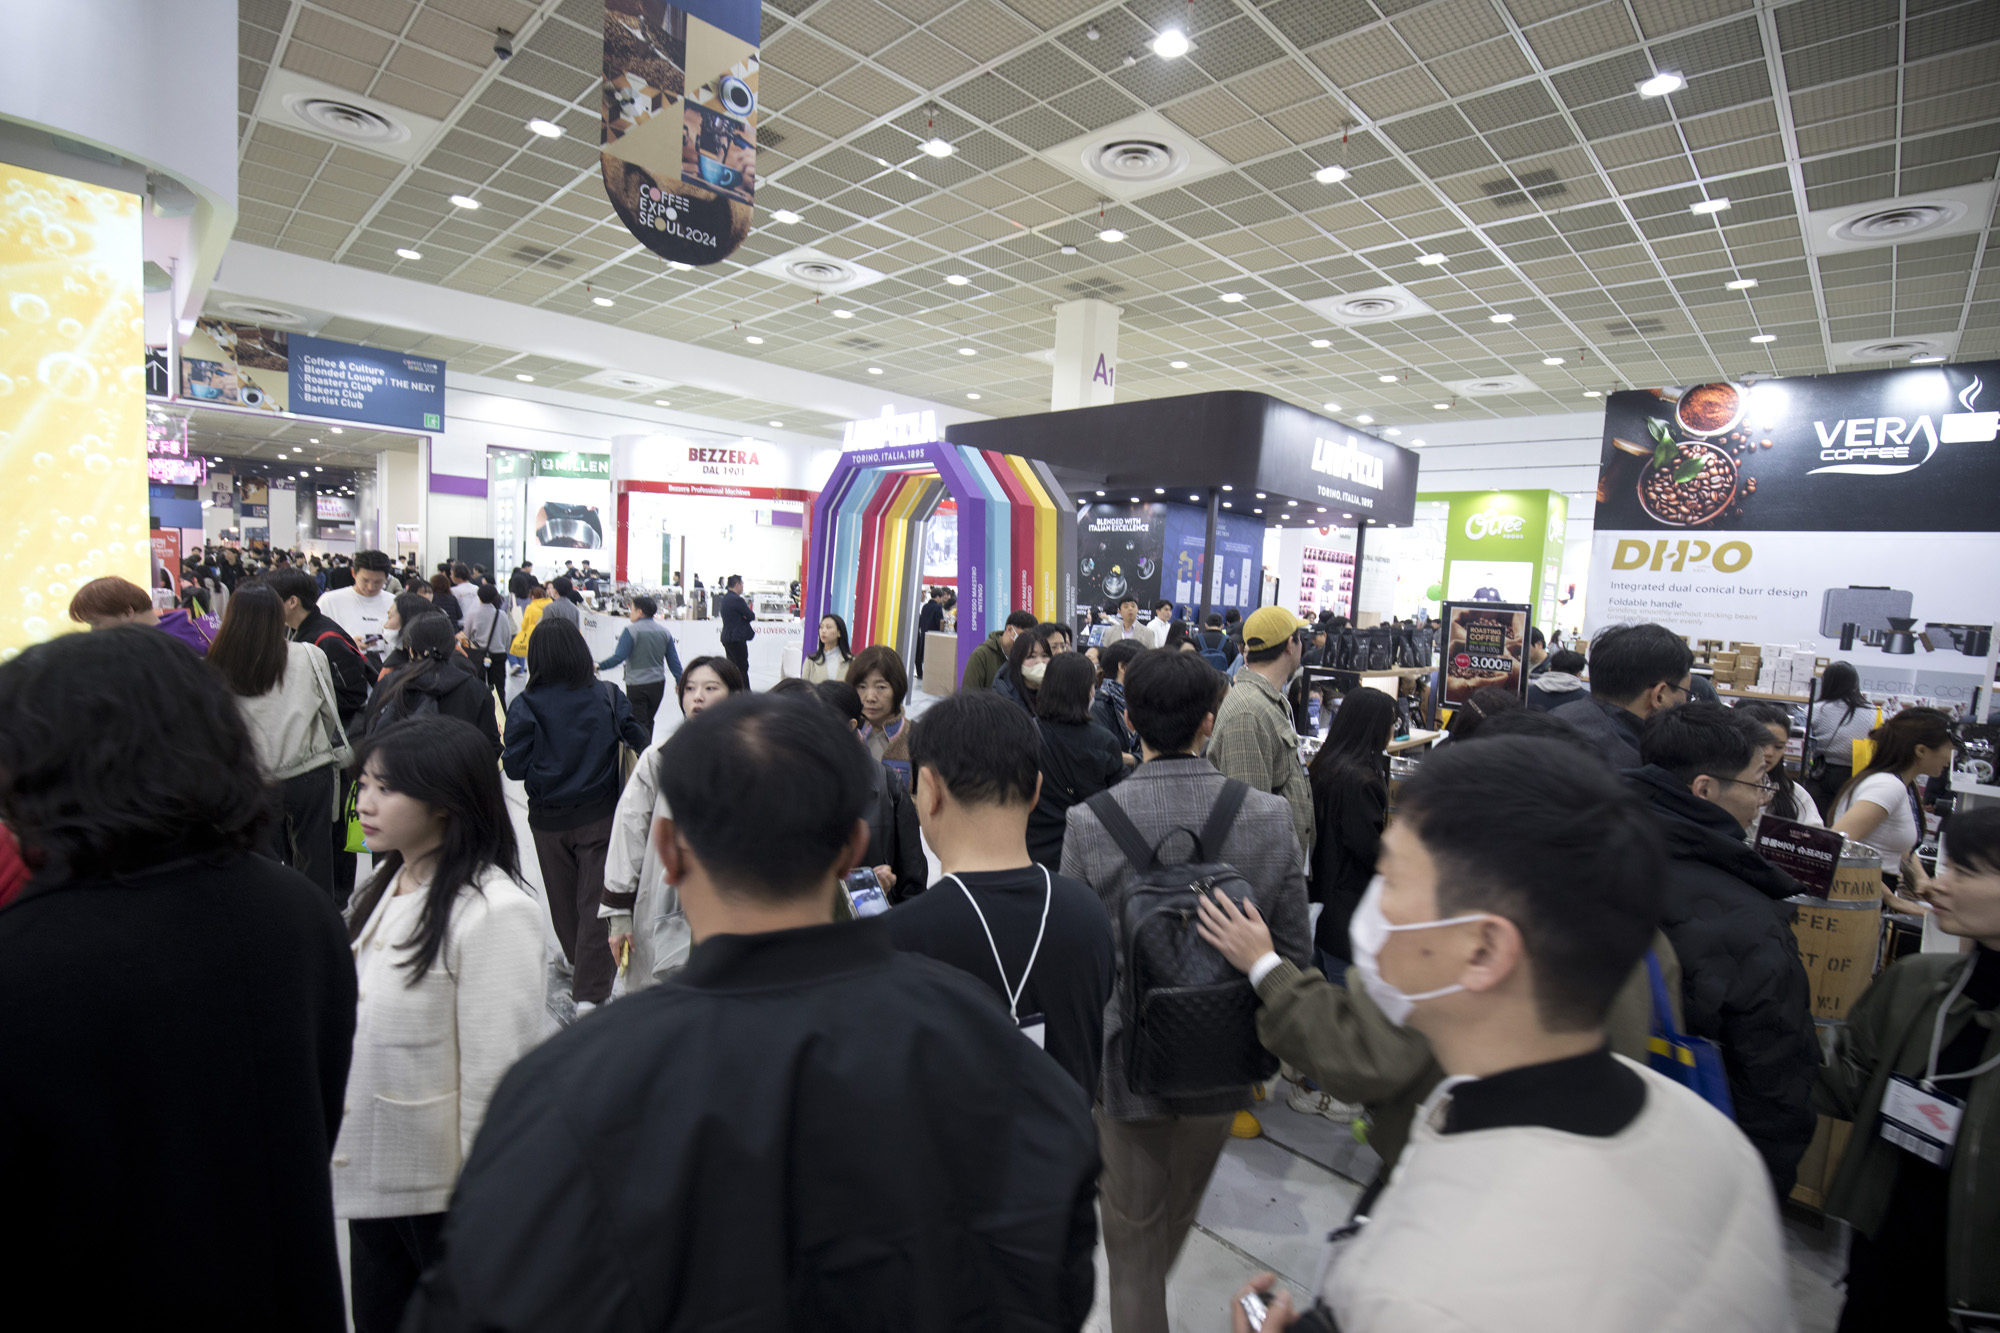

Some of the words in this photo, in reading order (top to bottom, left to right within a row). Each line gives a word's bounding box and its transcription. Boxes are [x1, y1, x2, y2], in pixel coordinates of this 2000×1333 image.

[640, 184, 690, 213] COFFEE
[639, 199, 678, 221] EXPO
[304, 355, 337, 369] Coffee
[339, 361, 346, 370] &
[349, 363, 385, 376] Culture
[304, 365, 346, 379] Blended
[348, 372, 383, 386] Lounge
[390, 378, 409, 389] THE
[411, 383, 436, 393] NEXT
[304, 374, 349, 389] Roasters
[352, 381, 373, 393] Club
[304, 384, 340, 397] Bakers
[342, 389, 365, 400] Club
[304, 393, 338, 406] Bartist
[340, 398, 363, 409] Club
[1814, 415, 1938, 449] VERA
[688, 447, 759, 465] BEZZERA
[907, 448, 925, 459] 1895
[1820, 446, 1910, 461] COFFEE
[555, 460, 609, 473] MILLEN
[702, 465, 719, 475] DAL
[723, 466, 745, 476] 1901
[691, 486, 724, 495] Professional
[725, 488, 751, 496] Machines
[1361, 497, 1374, 508] 1895
[1088, 524, 1111, 532] ITALIAN
[1111, 523, 1149, 532] EXCELLENCE
[1124, 517, 1141, 525] WITH
[1610, 581, 1665, 593] Integrated
[1668, 583, 1692, 593] dual
[1695, 584, 1735, 595] conical
[1739, 585, 1763, 596] burr
[1767, 586, 1808, 600] design
[1608, 597, 1648, 607] Foldable
[1650, 600, 1683, 609] handle
[1673, 609, 1701, 618] without
[1470, 627, 1502, 635] ROASTING
[1470, 634, 1501, 642] COFFEE
[1832, 881, 1875, 896] NTAIN
[1827, 957, 1853, 972] OF
